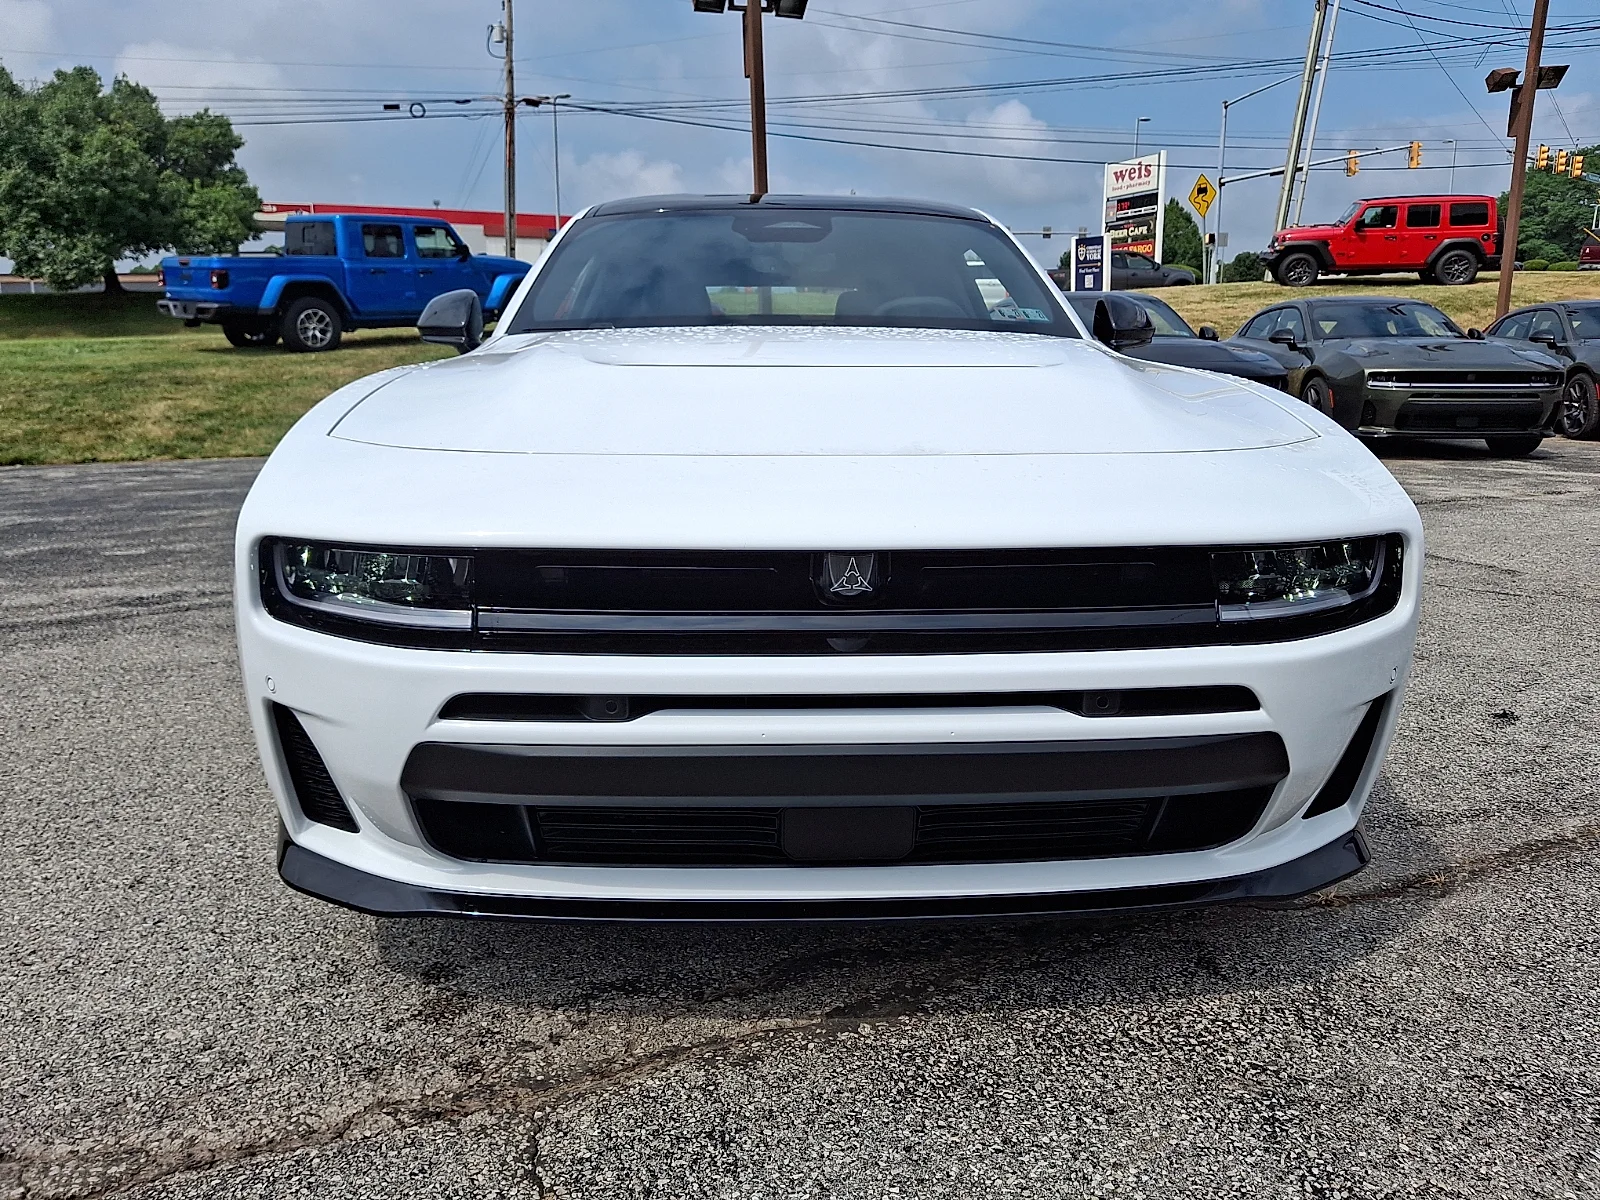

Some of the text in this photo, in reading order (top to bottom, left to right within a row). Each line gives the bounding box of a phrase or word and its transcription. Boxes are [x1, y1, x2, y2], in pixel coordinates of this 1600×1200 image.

[1113, 161, 1151, 184] weis
[1126, 180, 1151, 190] pharmacy
[1128, 226, 1148, 236] CAFE
[1129, 244, 1153, 253] FARGO
